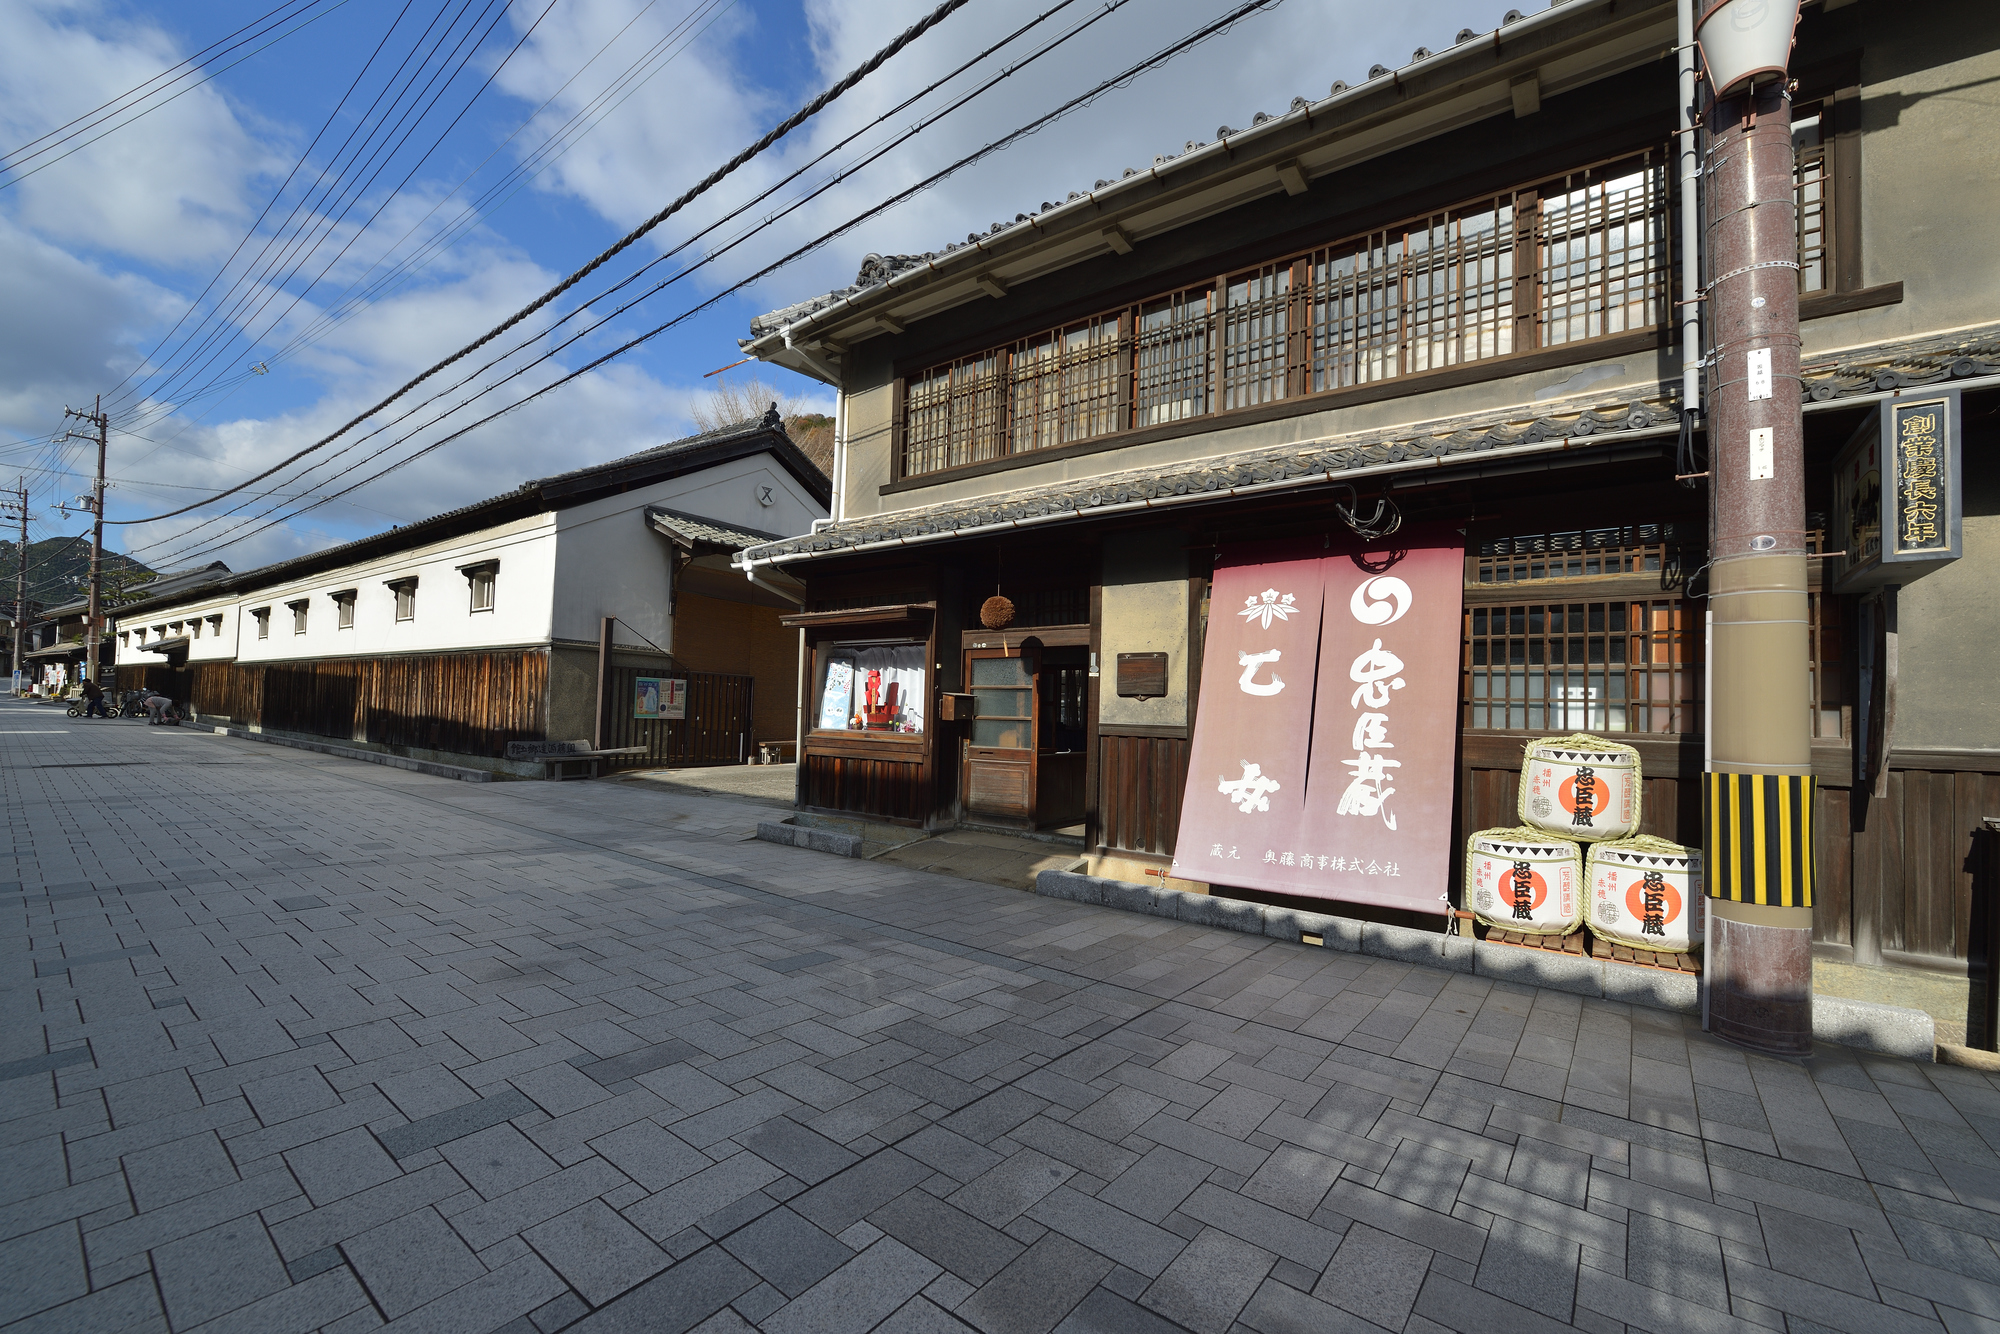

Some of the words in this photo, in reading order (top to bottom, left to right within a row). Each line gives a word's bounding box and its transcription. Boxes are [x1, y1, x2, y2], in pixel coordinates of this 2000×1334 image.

[1903, 413, 1937, 542] 創業慶長六年
[1218, 648, 1285, 813] 乙女
[1337, 638, 1406, 830] 忠臣蔵
[1572, 766, 1595, 827] 忠臣蔵
[1209, 843, 1241, 860] 蔵元
[1262, 848, 1401, 878] 奥藤商事株式会社
[1512, 861, 1533, 920] 忠臣蔵
[1641, 871, 1665, 936] 忠臣蔵
